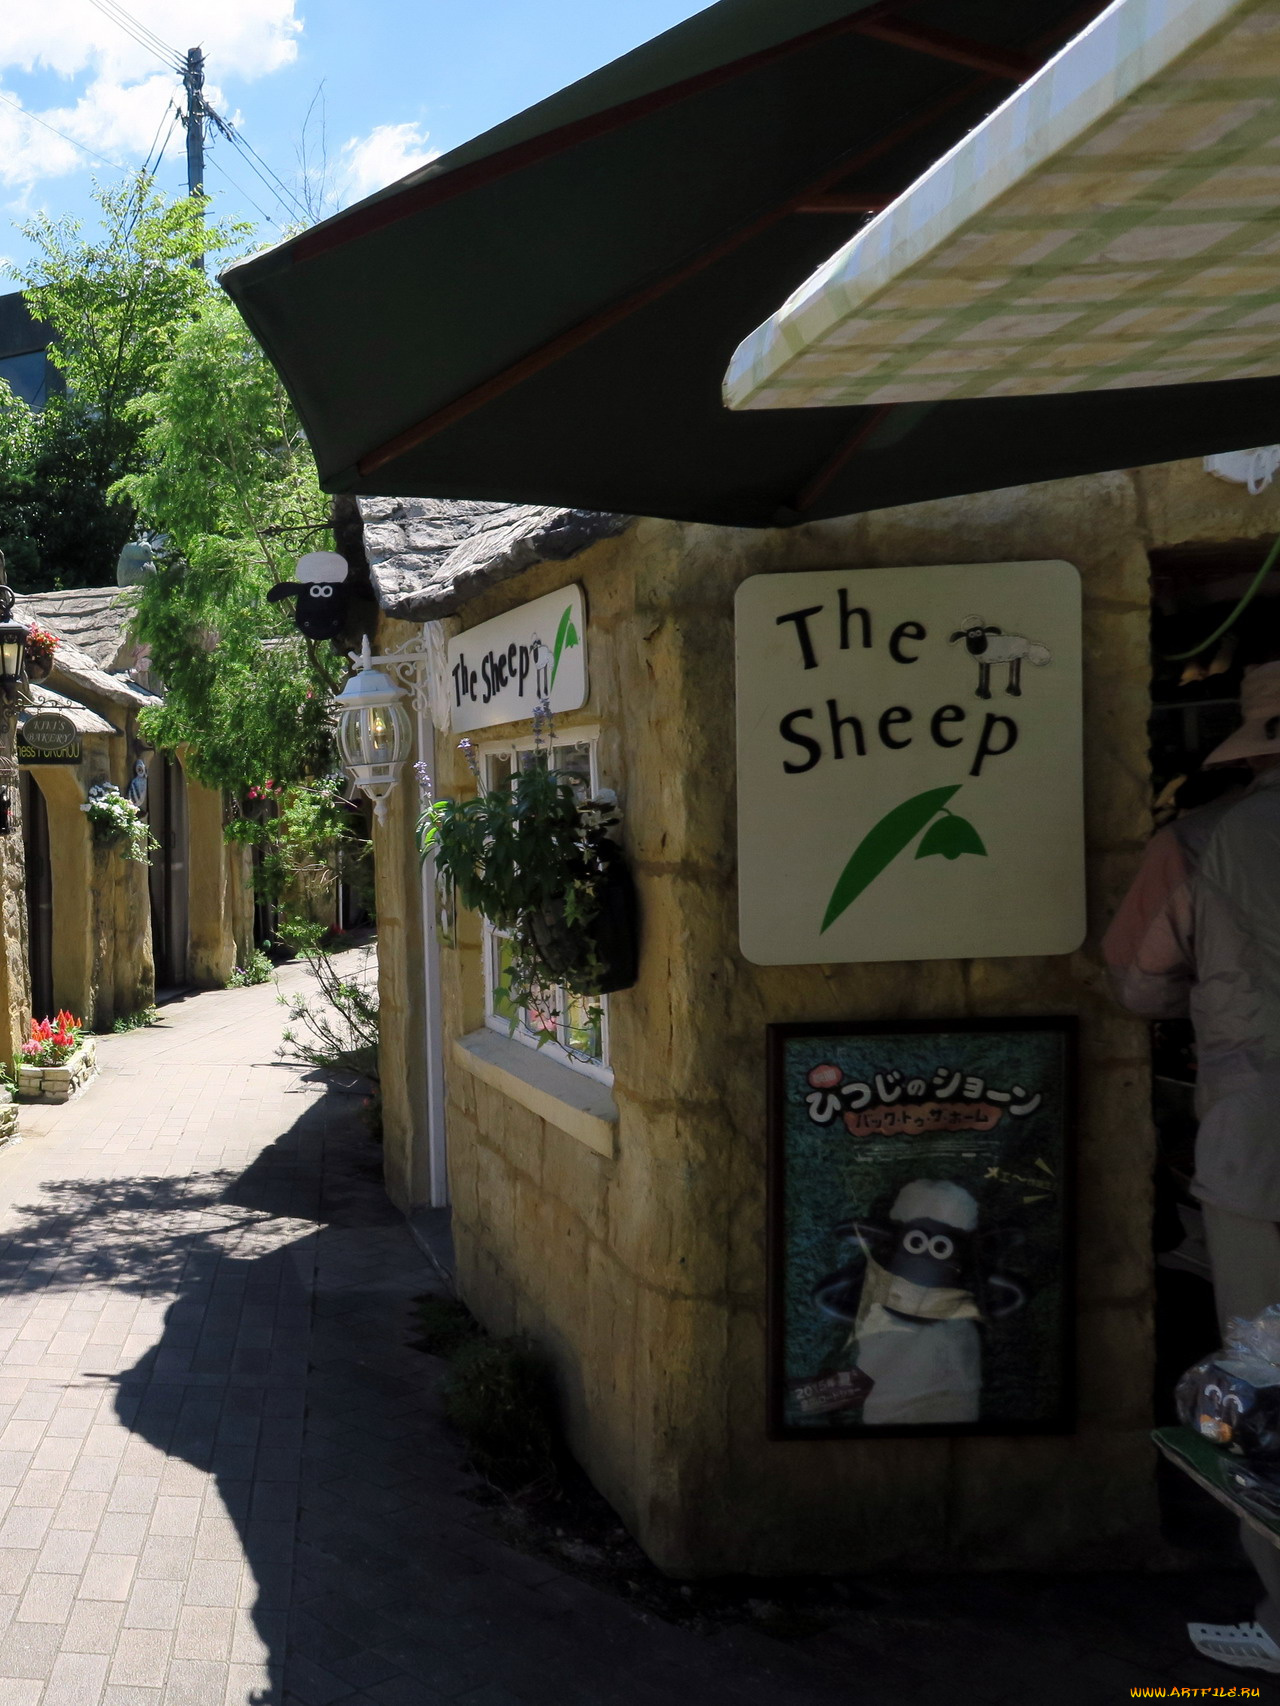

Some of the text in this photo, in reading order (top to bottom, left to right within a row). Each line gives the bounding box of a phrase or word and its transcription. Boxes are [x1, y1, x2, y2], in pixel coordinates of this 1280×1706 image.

[776, 587, 927, 670] The
[452, 643, 530, 707] The Sheep
[28, 733, 72, 744] BAKERY
[33, 720, 66, 731] KIKI'S
[778, 699, 1019, 777] Sheep
[805, 1066, 1043, 1123] ひつじのショーン
